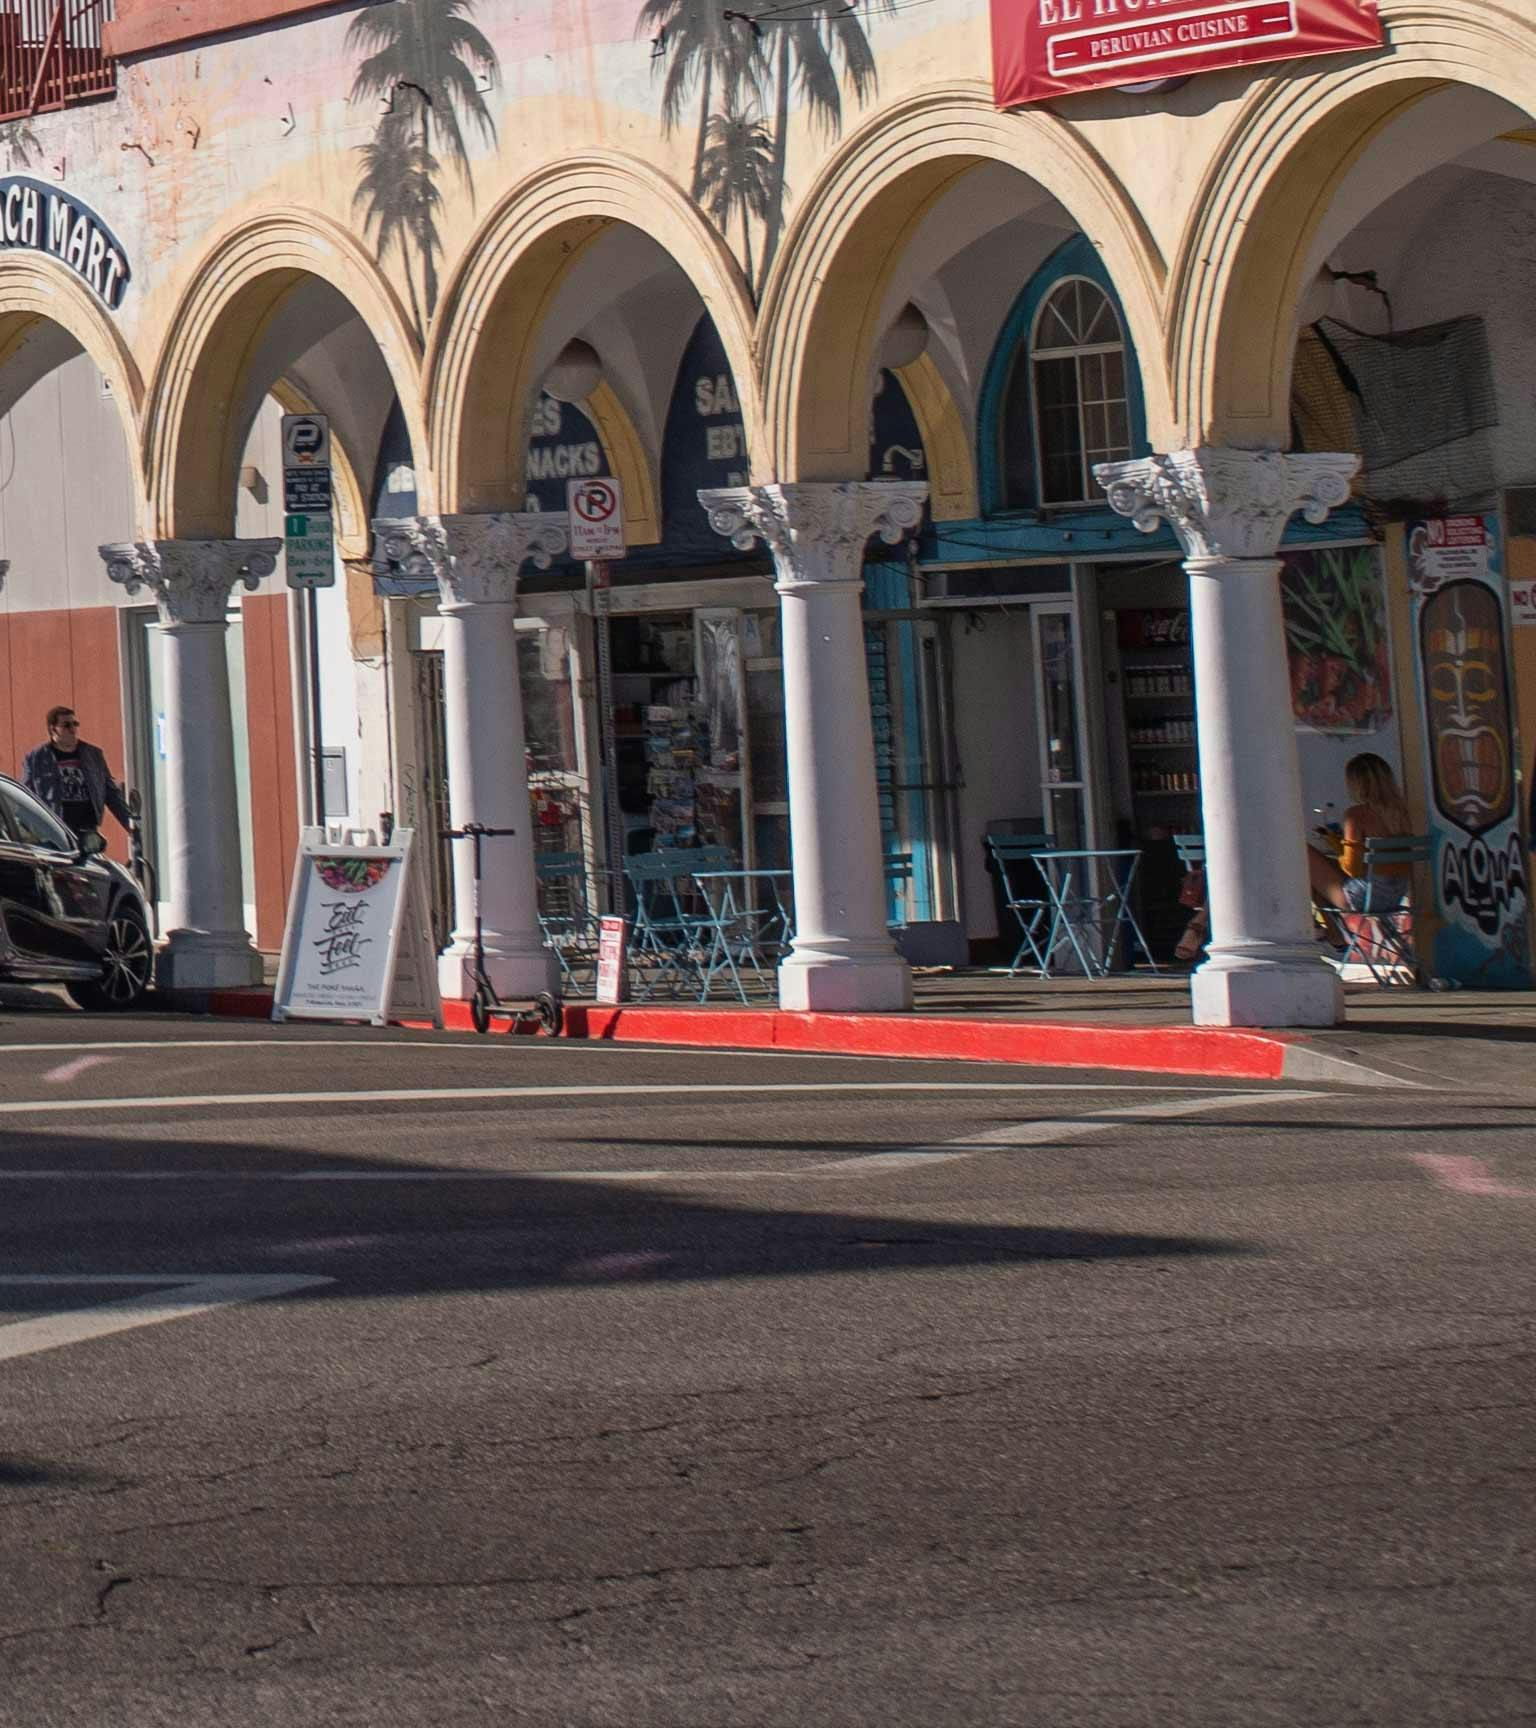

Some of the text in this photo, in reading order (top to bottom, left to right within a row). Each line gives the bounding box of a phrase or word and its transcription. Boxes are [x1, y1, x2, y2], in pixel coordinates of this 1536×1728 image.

[1090, 15, 1249, 58] PERUVIAN CUISINE
[48, 194, 123, 305] MART
[528, 441, 601, 480] NACKS
[1444, 835, 1526, 906] ALOHA
[321, 900, 369, 932] Eat
